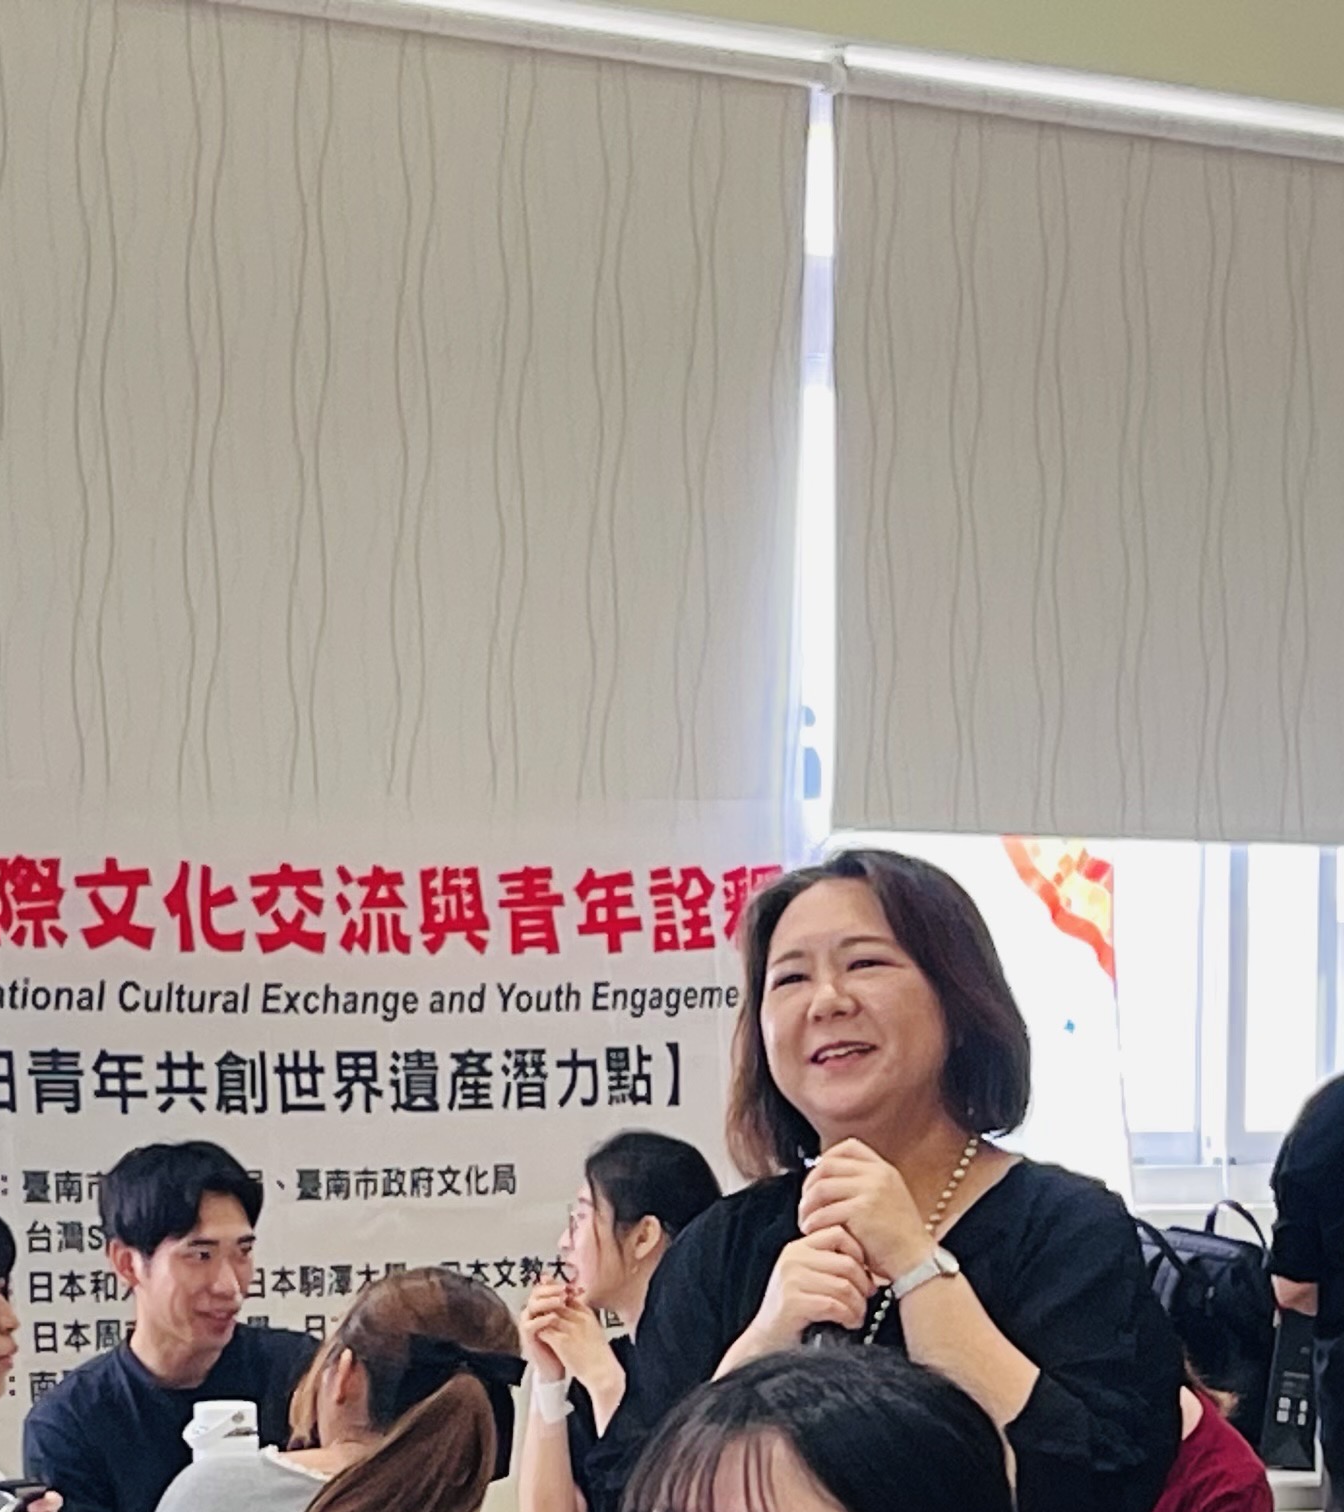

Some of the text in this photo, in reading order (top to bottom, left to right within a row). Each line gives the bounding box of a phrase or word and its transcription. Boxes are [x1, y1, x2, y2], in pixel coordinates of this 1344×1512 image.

[118, 981, 249, 1014] Cultural
[262, 982, 419, 1022] Exchange
[430, 983, 487, 1014] and
[497, 982, 581, 1013] Youth
[591, 981, 739, 1017] Engageme
[26, 1218, 104, 1253] 台灣S
[29, 1268, 135, 1303] 日本和
